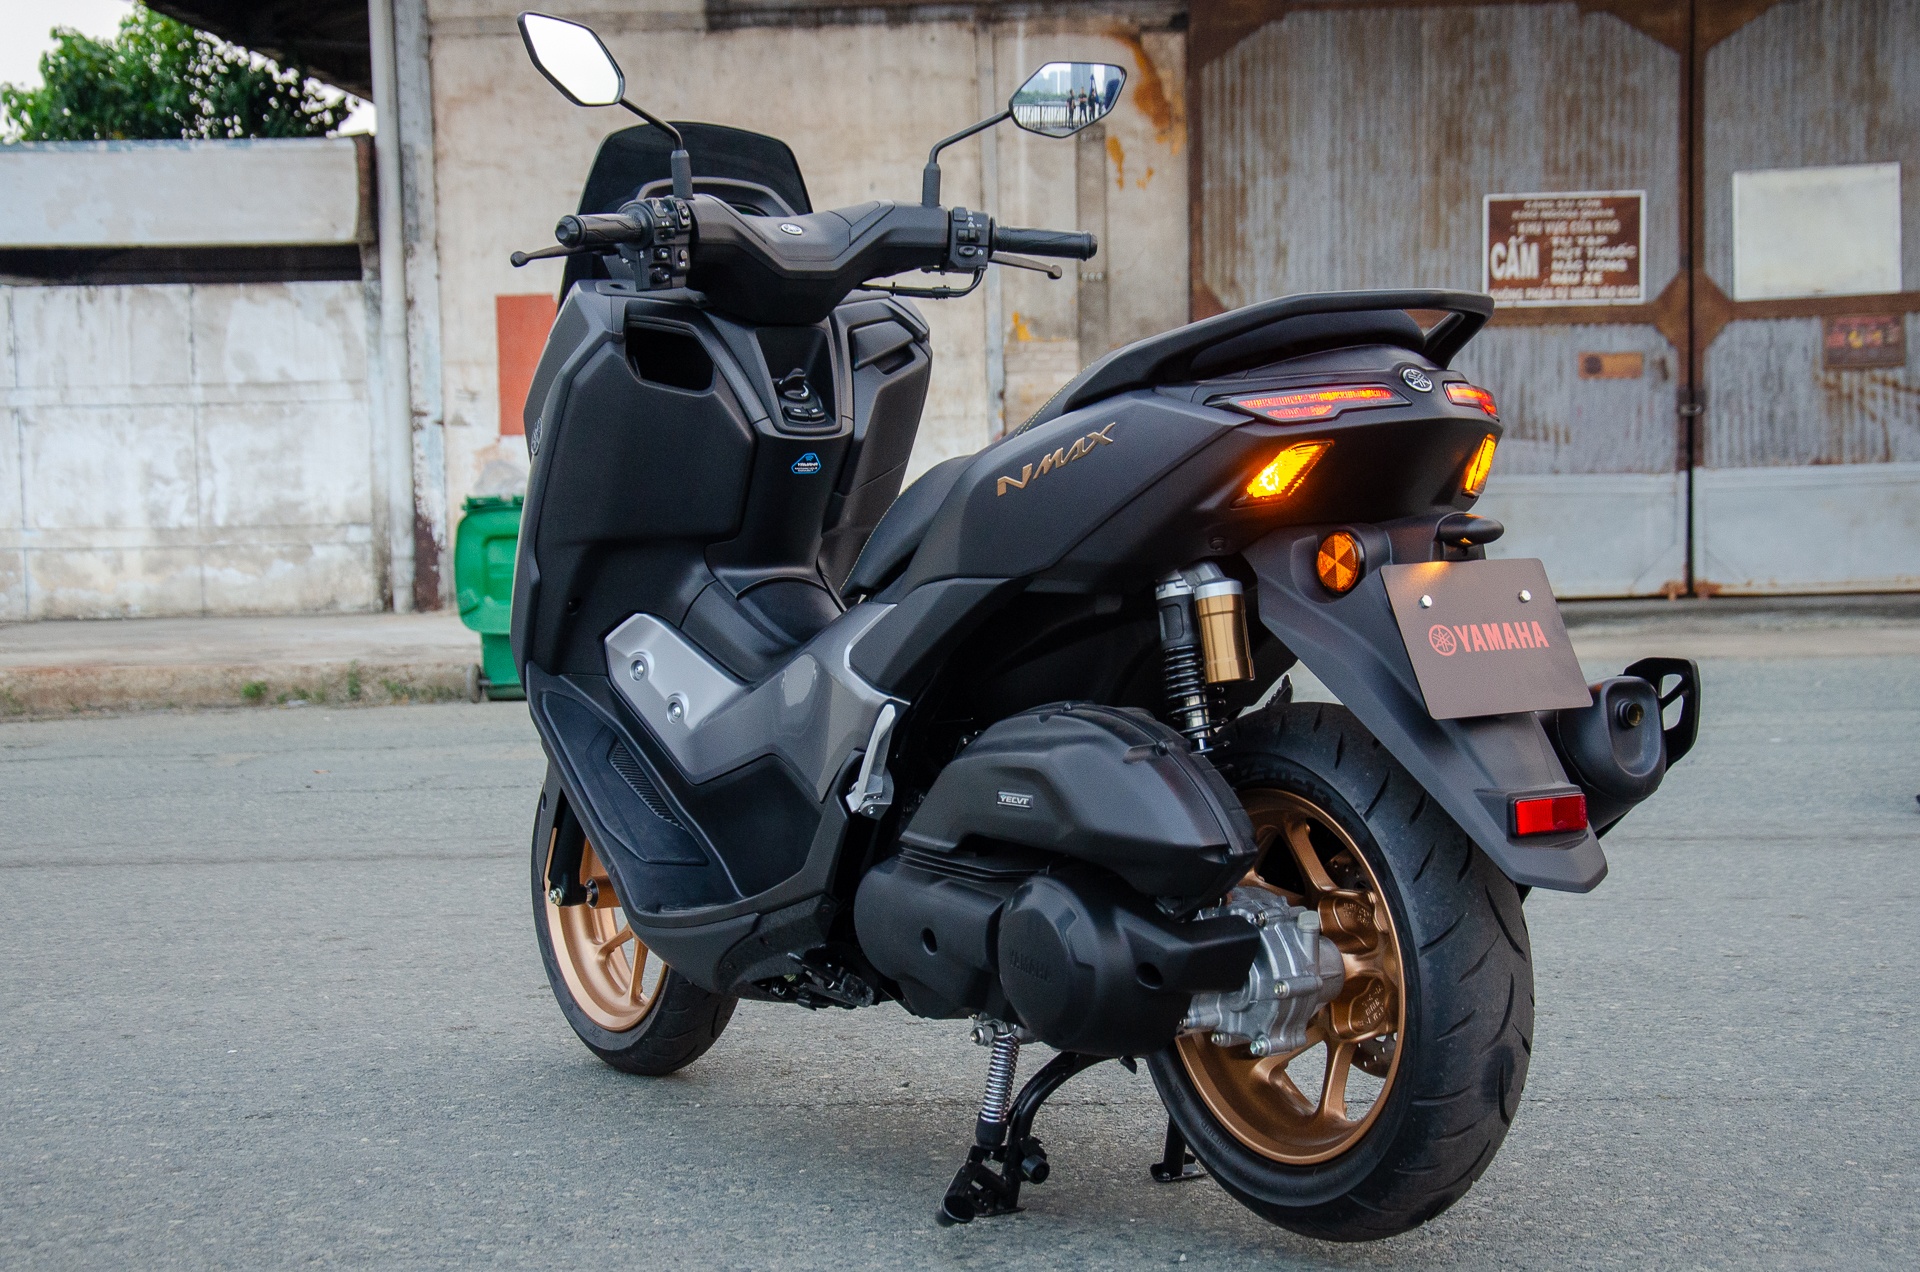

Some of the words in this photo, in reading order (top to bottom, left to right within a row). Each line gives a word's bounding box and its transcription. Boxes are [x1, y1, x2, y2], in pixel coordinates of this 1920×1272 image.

[1490, 234, 1540, 280] CẤM
[997, 422, 1116, 496] NMAX
[1452, 620, 1550, 653] YAMAHA
[1000, 794, 1029, 804] YECVT
